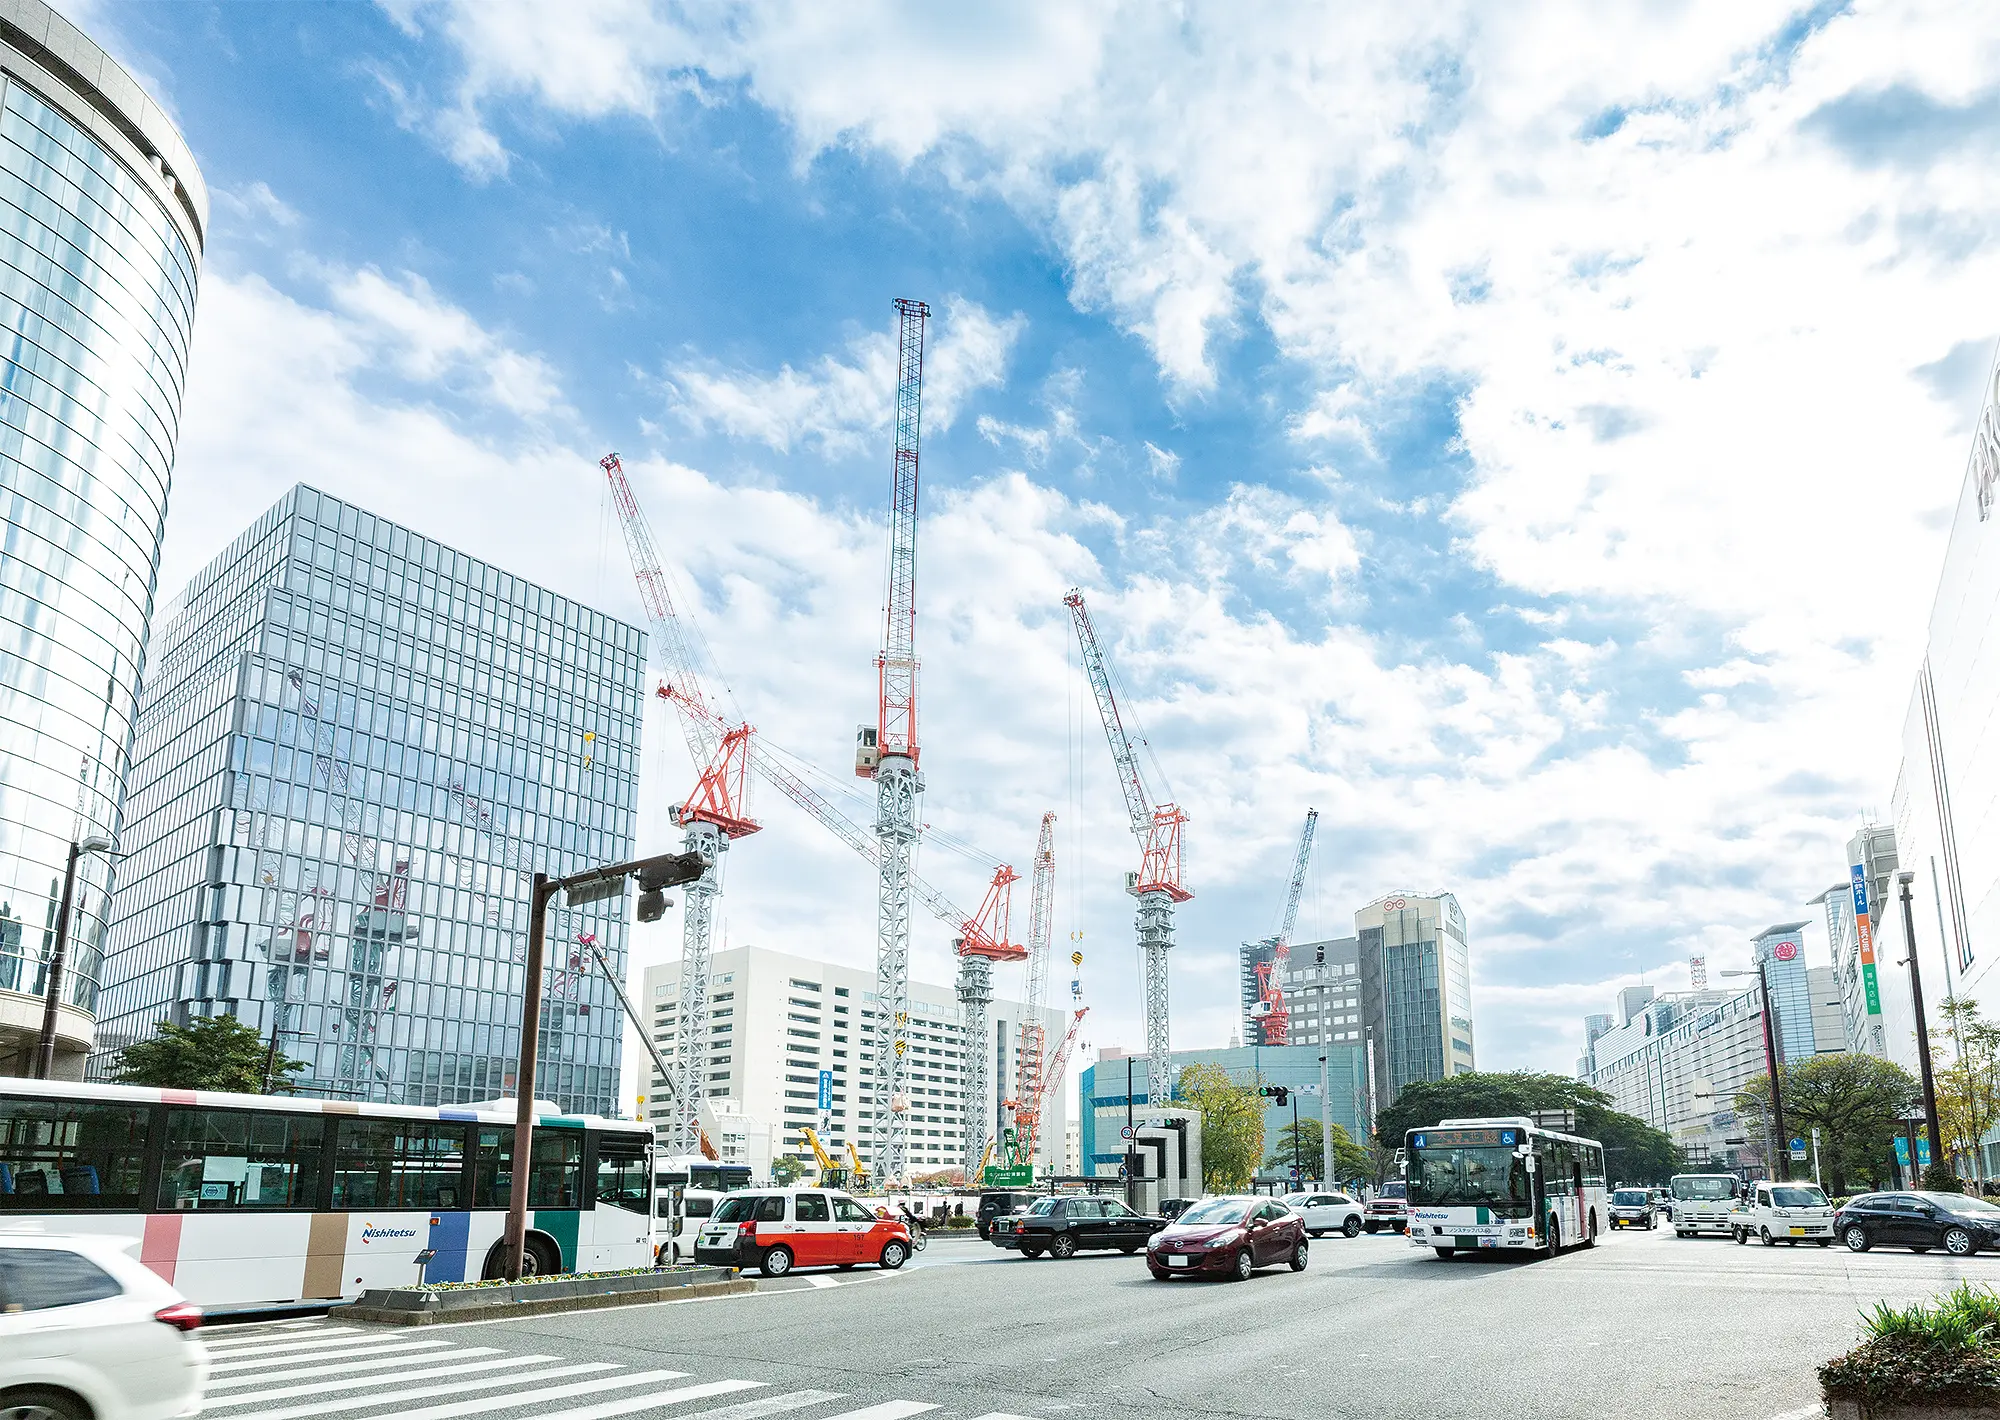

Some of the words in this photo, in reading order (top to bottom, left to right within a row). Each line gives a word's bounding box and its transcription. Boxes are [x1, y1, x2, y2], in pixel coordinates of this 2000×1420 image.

[1860, 925, 1870, 953] INCUBE
[1414, 1212, 1448, 1220] Nishitetsu
[361, 1227, 416, 1239] Nishitetsu
